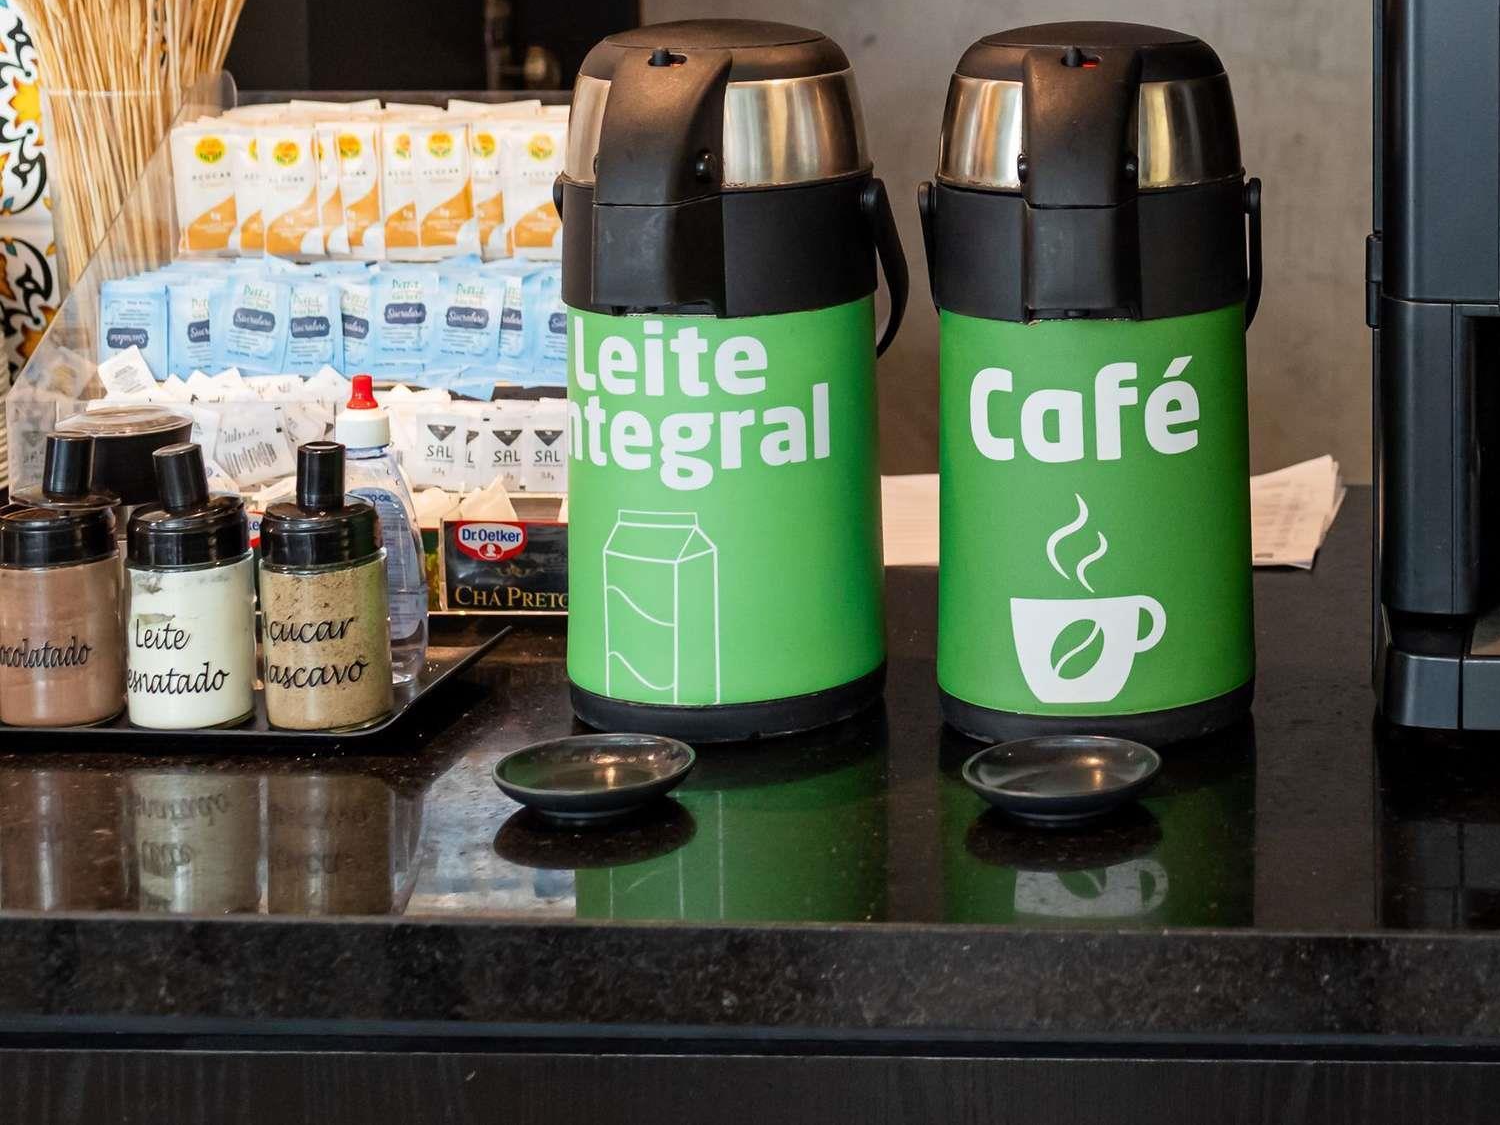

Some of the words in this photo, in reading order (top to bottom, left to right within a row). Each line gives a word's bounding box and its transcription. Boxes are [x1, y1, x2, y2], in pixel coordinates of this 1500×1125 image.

[573, 316, 768, 397] Leite
[969, 355, 1200, 463] Café
[426, 445, 453, 459] SAL
[568, 382, 831, 491] ntegral
[493, 450, 521, 463] SAL
[534, 450, 561, 463] SAL
[135, 618, 191, 650] Leite
[127, 661, 231, 695] esnatado
